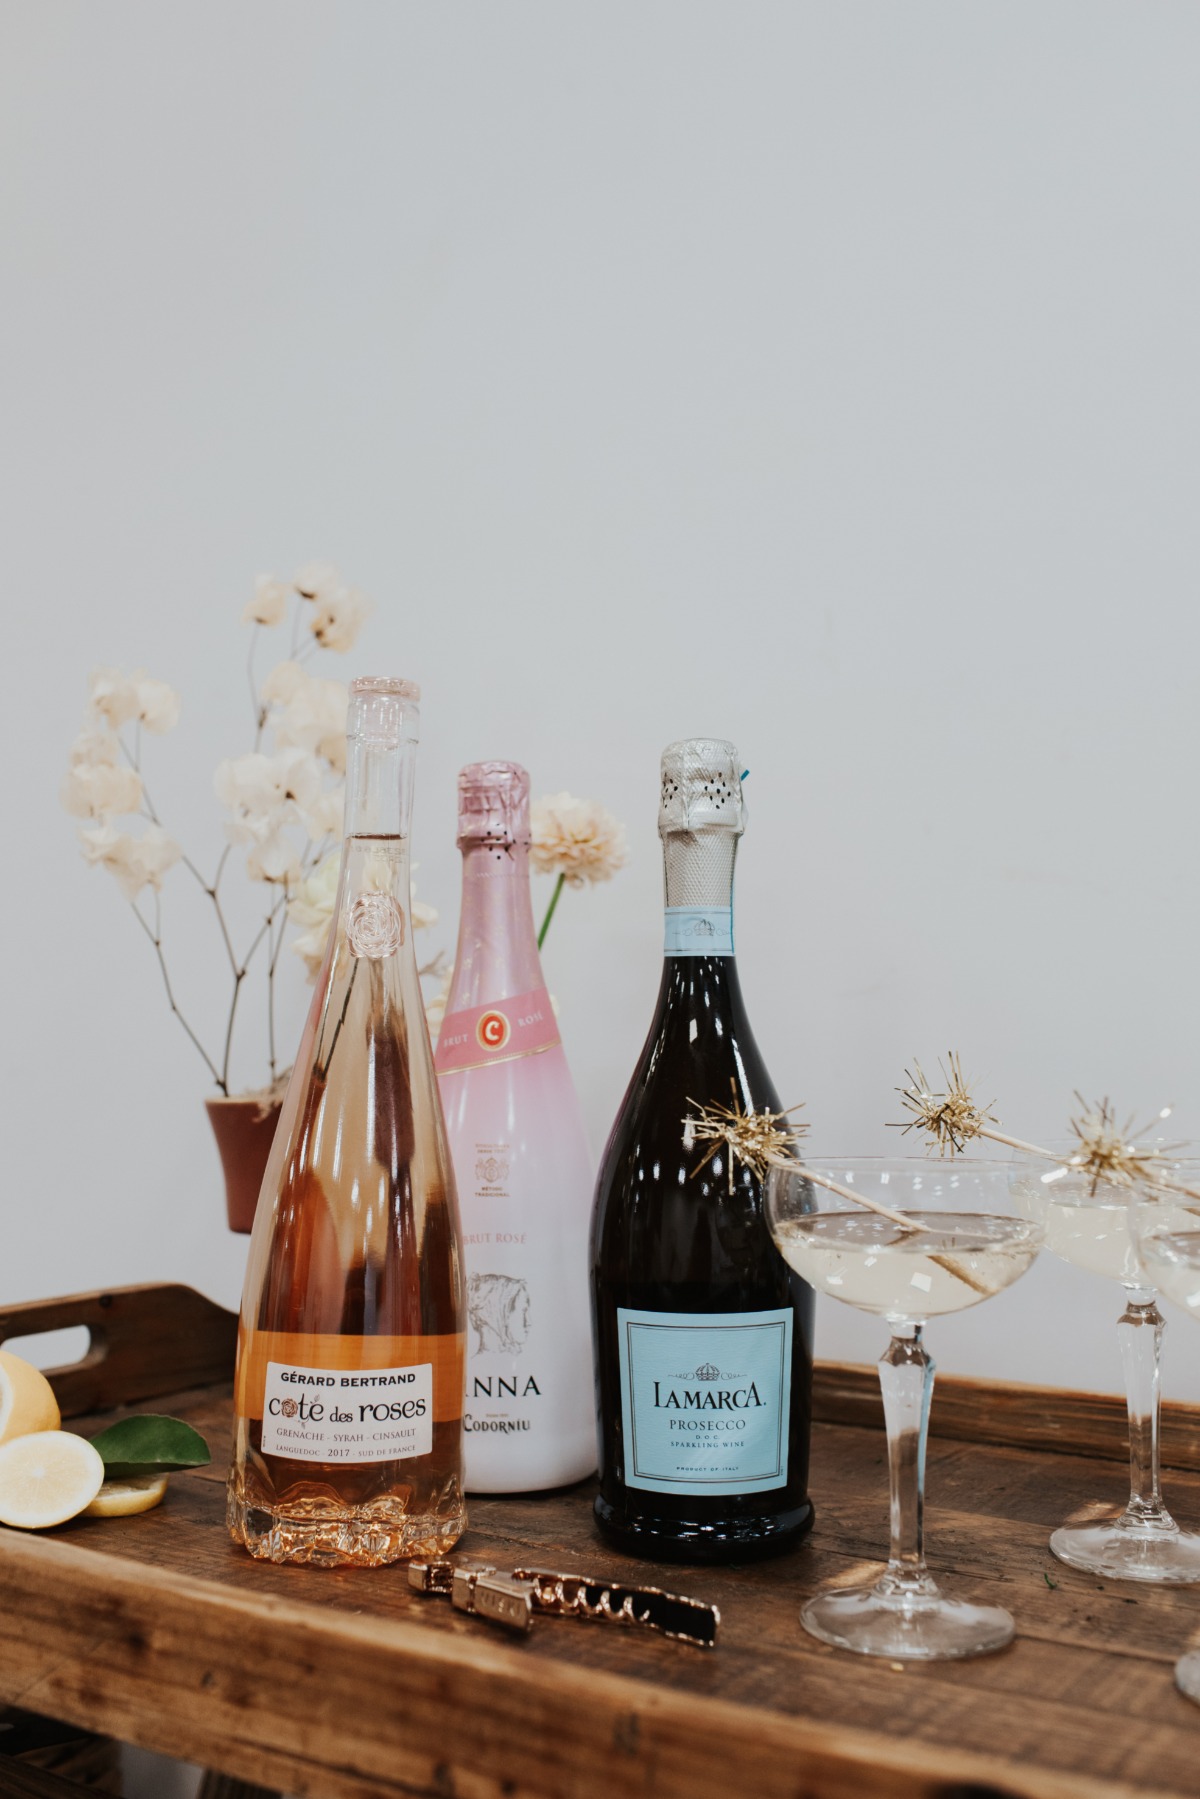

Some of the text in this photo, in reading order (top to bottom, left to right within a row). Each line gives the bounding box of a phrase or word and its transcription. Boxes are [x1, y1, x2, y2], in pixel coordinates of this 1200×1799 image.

[280, 1371, 416, 1387] GÉRARD BERTRAND
[466, 1375, 542, 1398] NNA
[329, 1406, 353, 1423] des
[358, 1398, 426, 1422] roses
[669, 1419, 746, 1431] PROSECCO
[276, 1427, 325, 1441] GRENACHE
[333, 1433, 363, 1442] SYRAH
[372, 1428, 416, 1441] CINSAULT
[276, 1444, 416, 1457] LANGUEDOC 2017 SUD DE FRANCE
